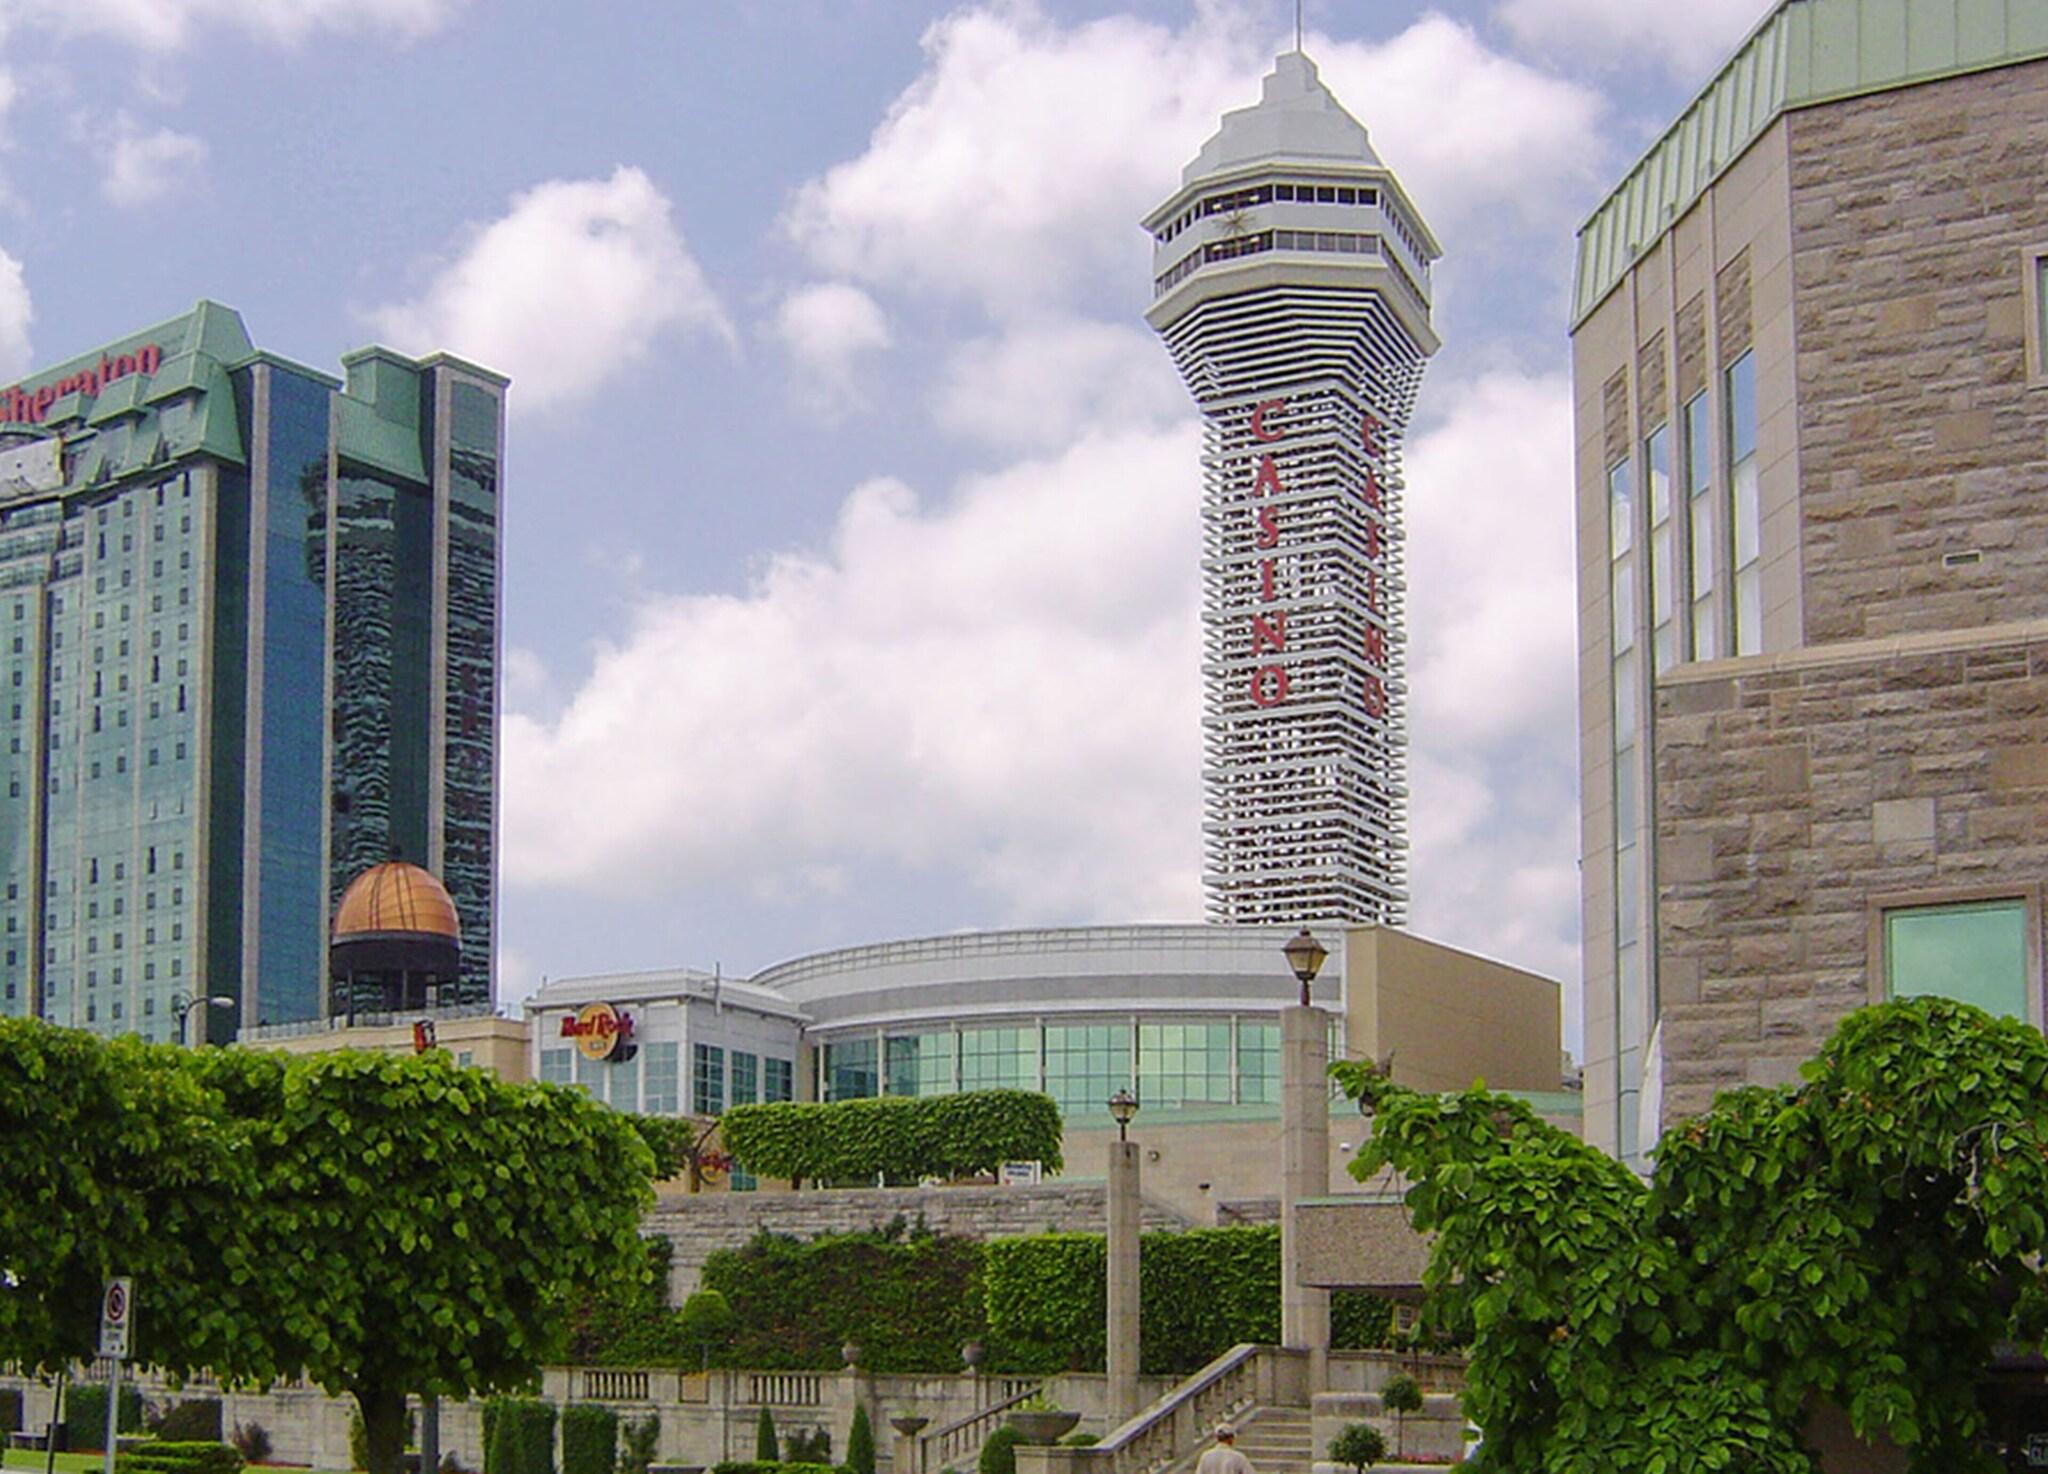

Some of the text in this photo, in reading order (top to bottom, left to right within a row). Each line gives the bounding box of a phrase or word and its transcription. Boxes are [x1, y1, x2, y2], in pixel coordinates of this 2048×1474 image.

[1250, 400, 1288, 706] CASINO
[1360, 415, 1384, 718] CASINO
[561, 1012, 634, 1038] Hard Rock
